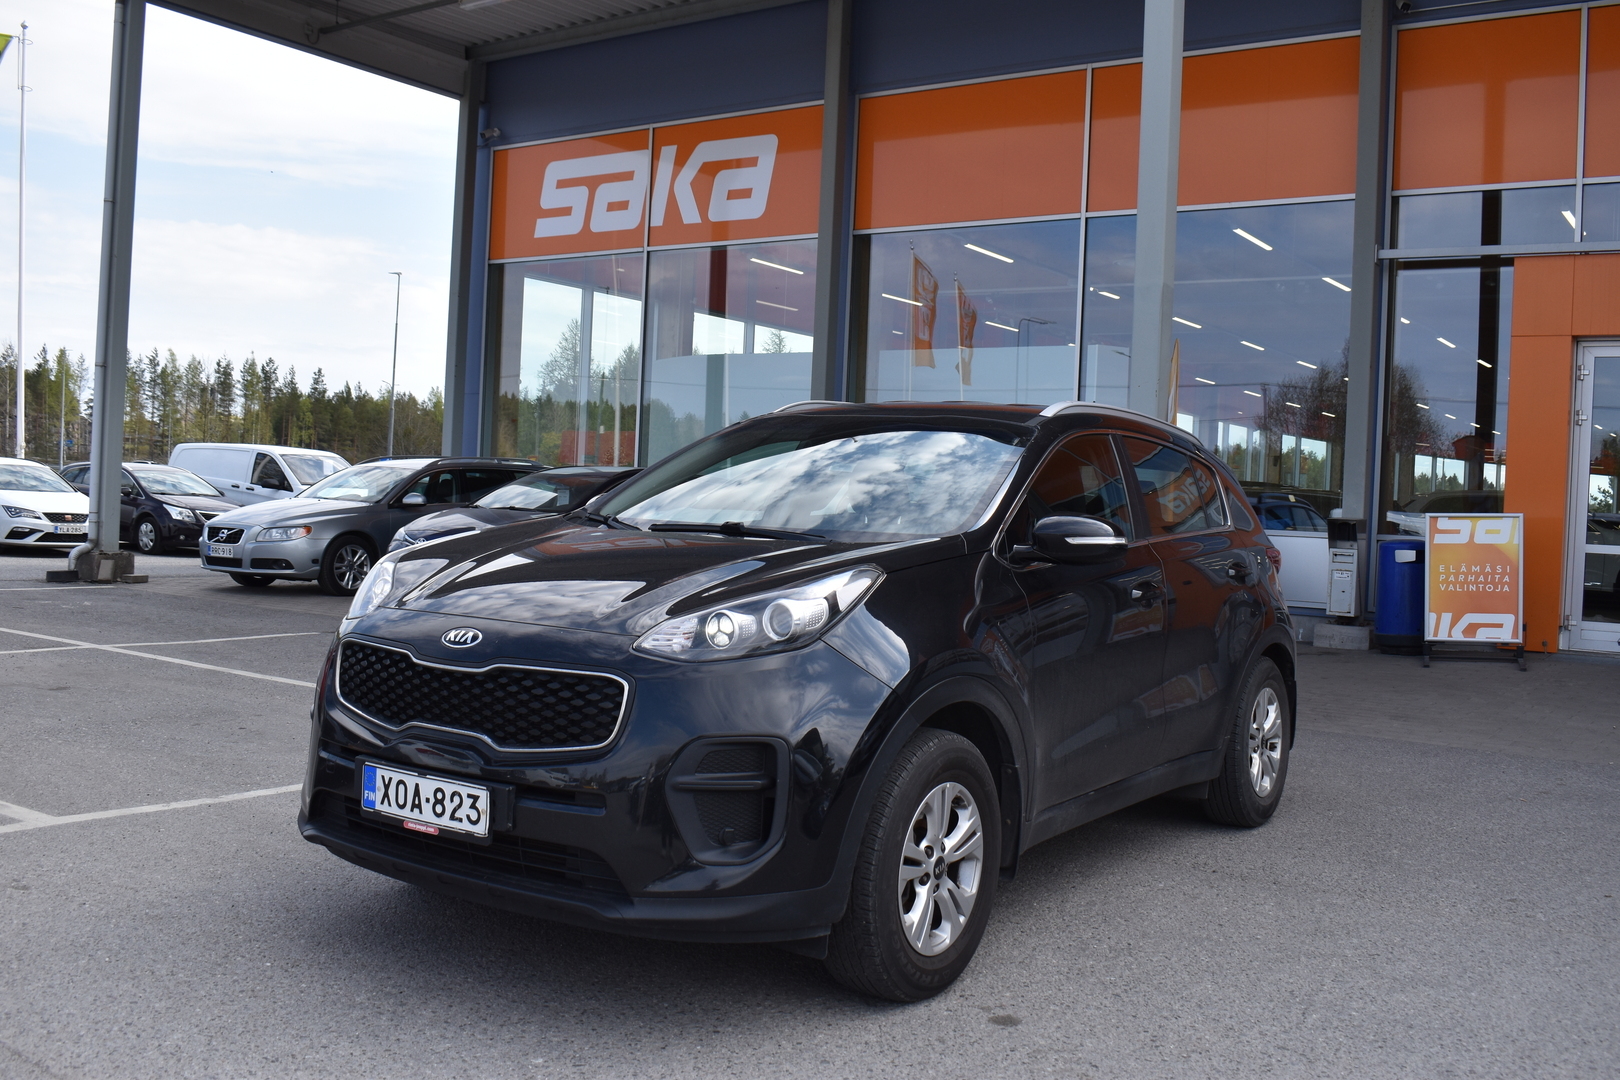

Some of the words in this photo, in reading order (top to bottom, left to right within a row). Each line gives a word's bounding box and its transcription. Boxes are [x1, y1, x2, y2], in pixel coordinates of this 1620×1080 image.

[1439, 563, 1510, 573] ELÄMÄSI
[1439, 574, 1510, 583] PARHAITA
[1439, 583, 1510, 592] VALINTOJA
[446, 629, 475, 644] KIA
[364, 790, 376, 801] FIN
[380, 774, 482, 826] XOA-823
[935, 862, 945, 875] KIA
